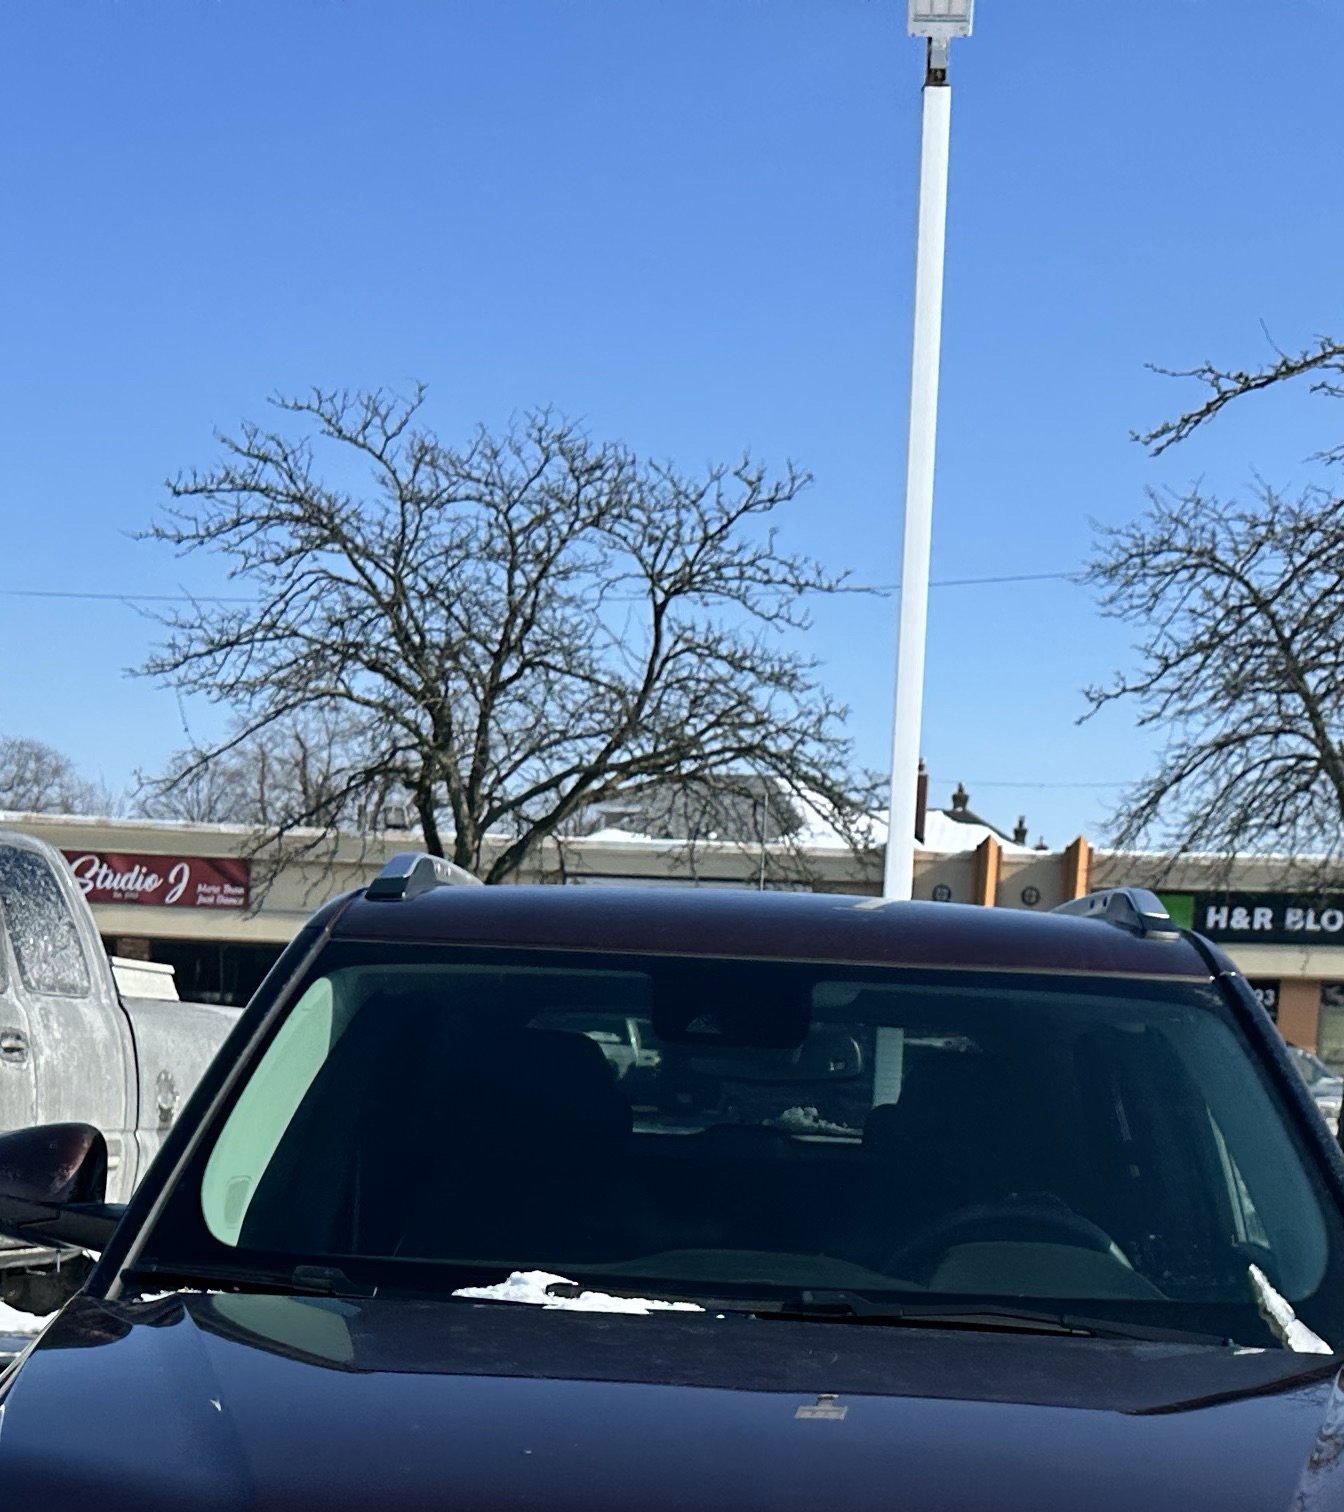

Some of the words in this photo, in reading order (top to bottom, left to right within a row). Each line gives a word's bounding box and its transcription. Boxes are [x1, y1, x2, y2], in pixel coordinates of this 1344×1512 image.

[71, 855, 163, 894] Studio
[165, 862, 190, 904] J
[1206, 906, 1273, 931] H&R
